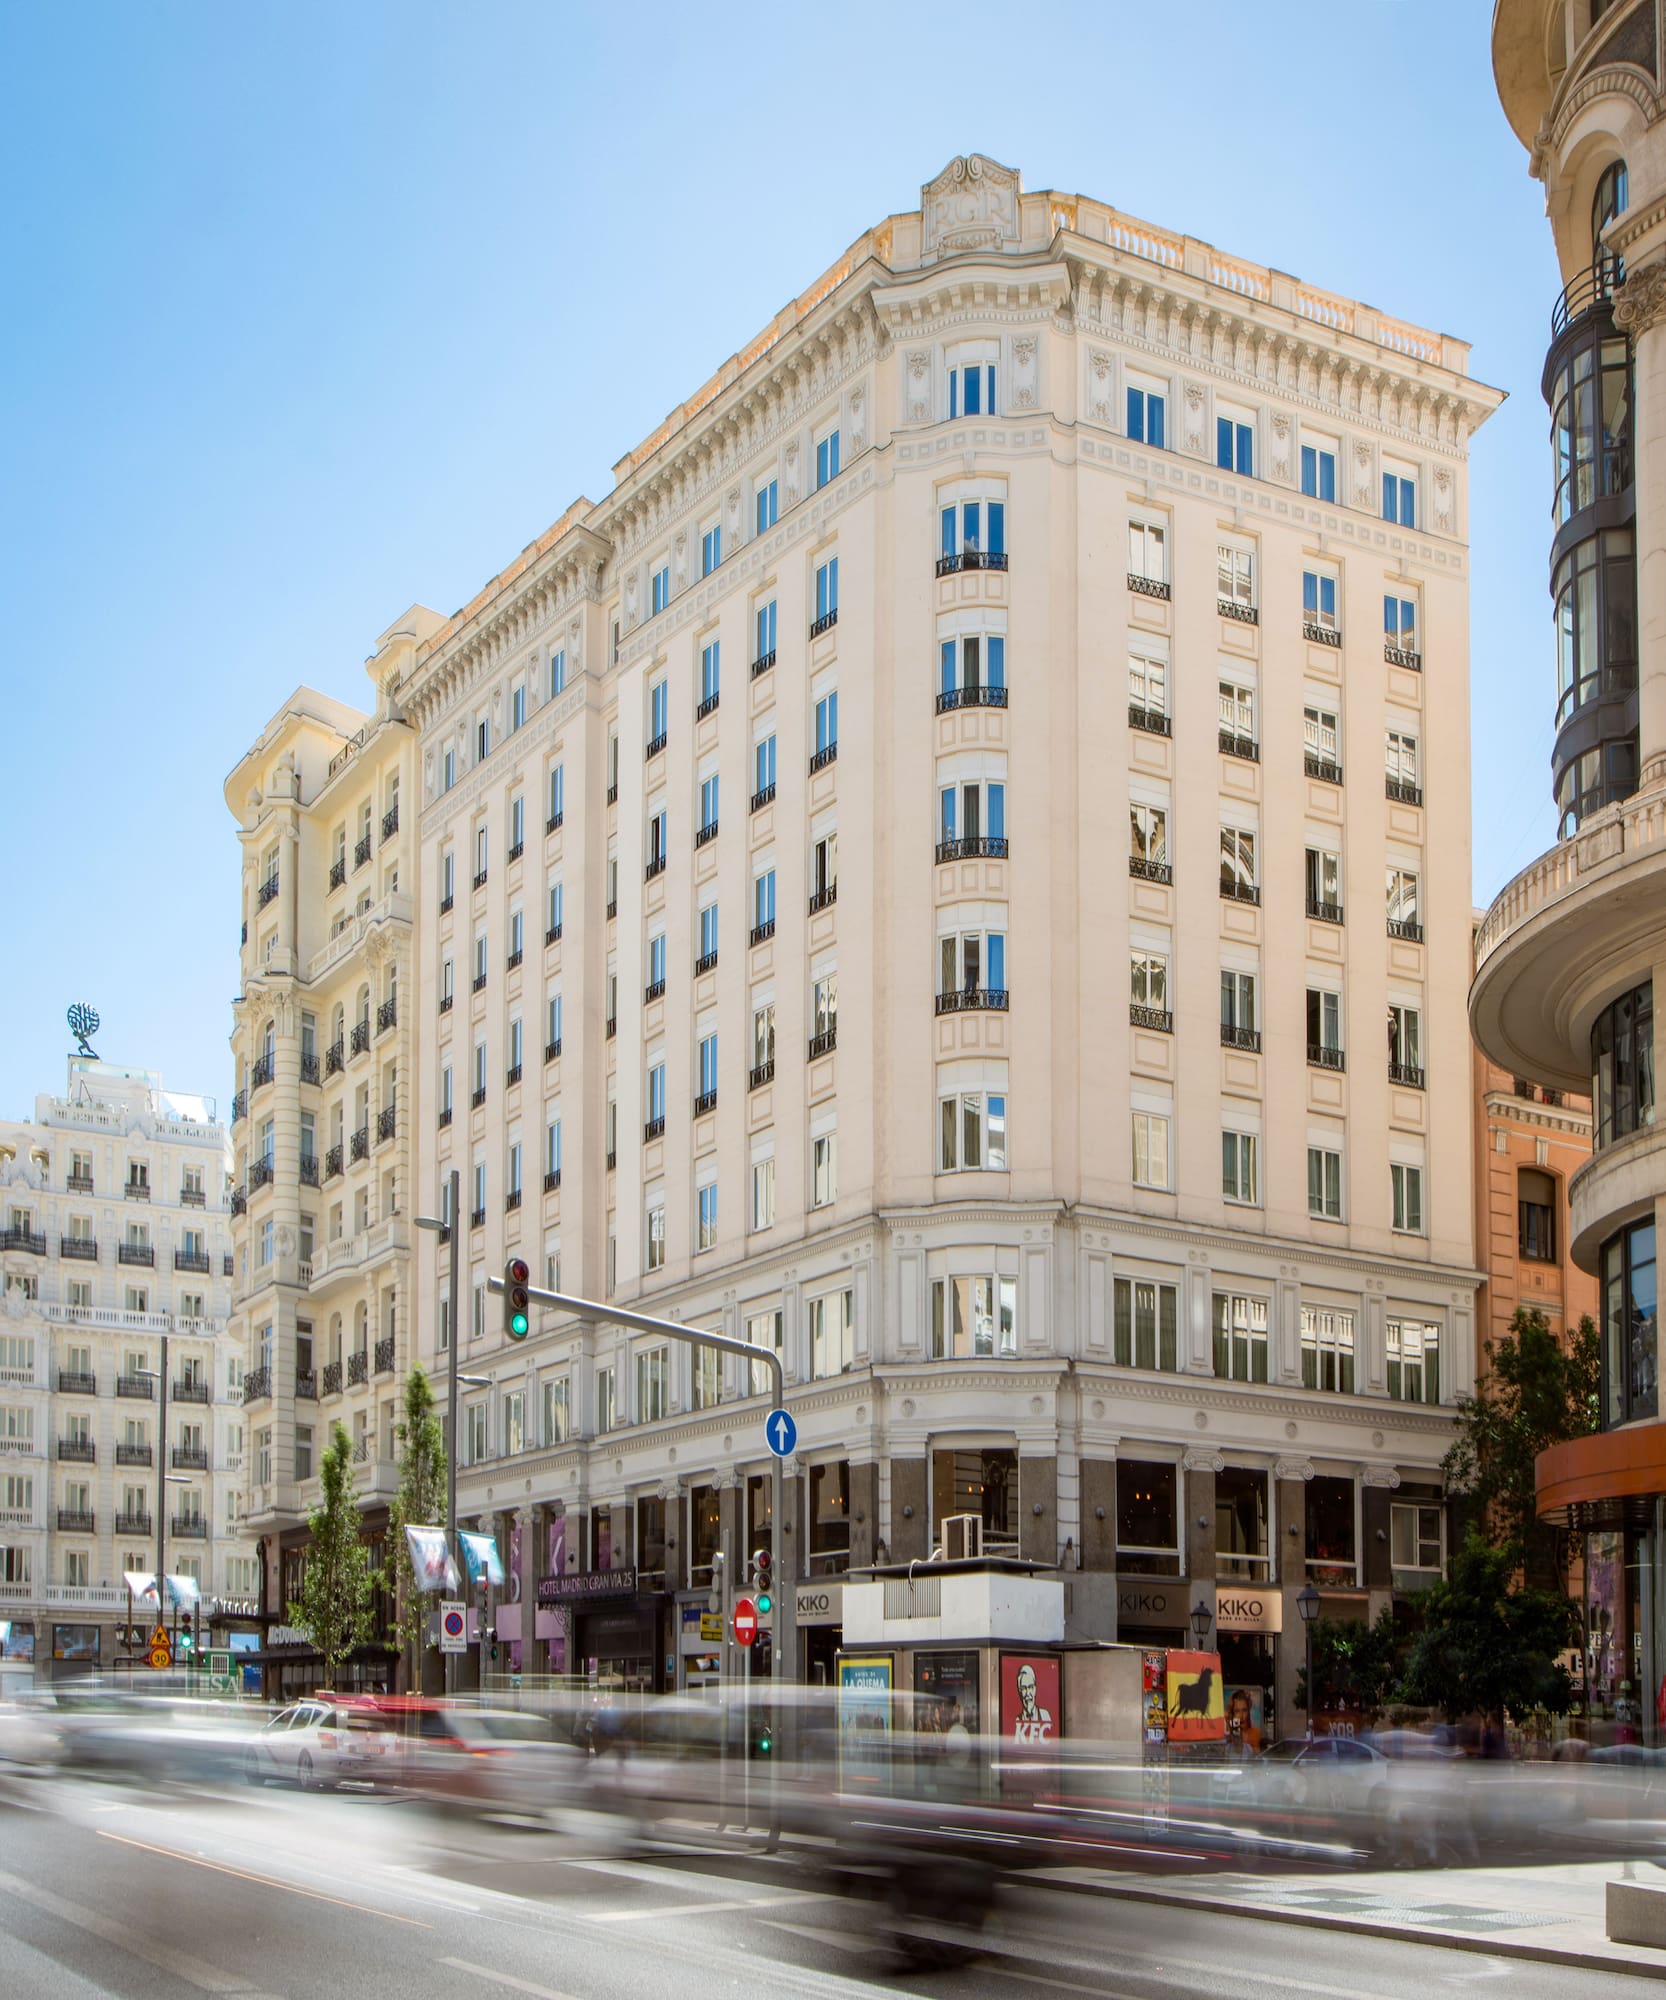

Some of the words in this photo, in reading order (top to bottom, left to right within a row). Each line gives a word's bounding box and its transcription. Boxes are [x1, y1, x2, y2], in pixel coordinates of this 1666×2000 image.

[539, 1581, 560, 1596] HOTEL
[561, 1577, 587, 1593] MADRD
[589, 1575, 609, 1590] GRAN
[623, 1571, 633, 1587] 25
[797, 1594, 829, 1611] KIKO
[1119, 1594, 1167, 1612] KIKO
[1218, 1598, 1263, 1617] KIKO
[154, 1655, 166, 1664] 30
[1013, 1722, 1053, 1745] KFC
